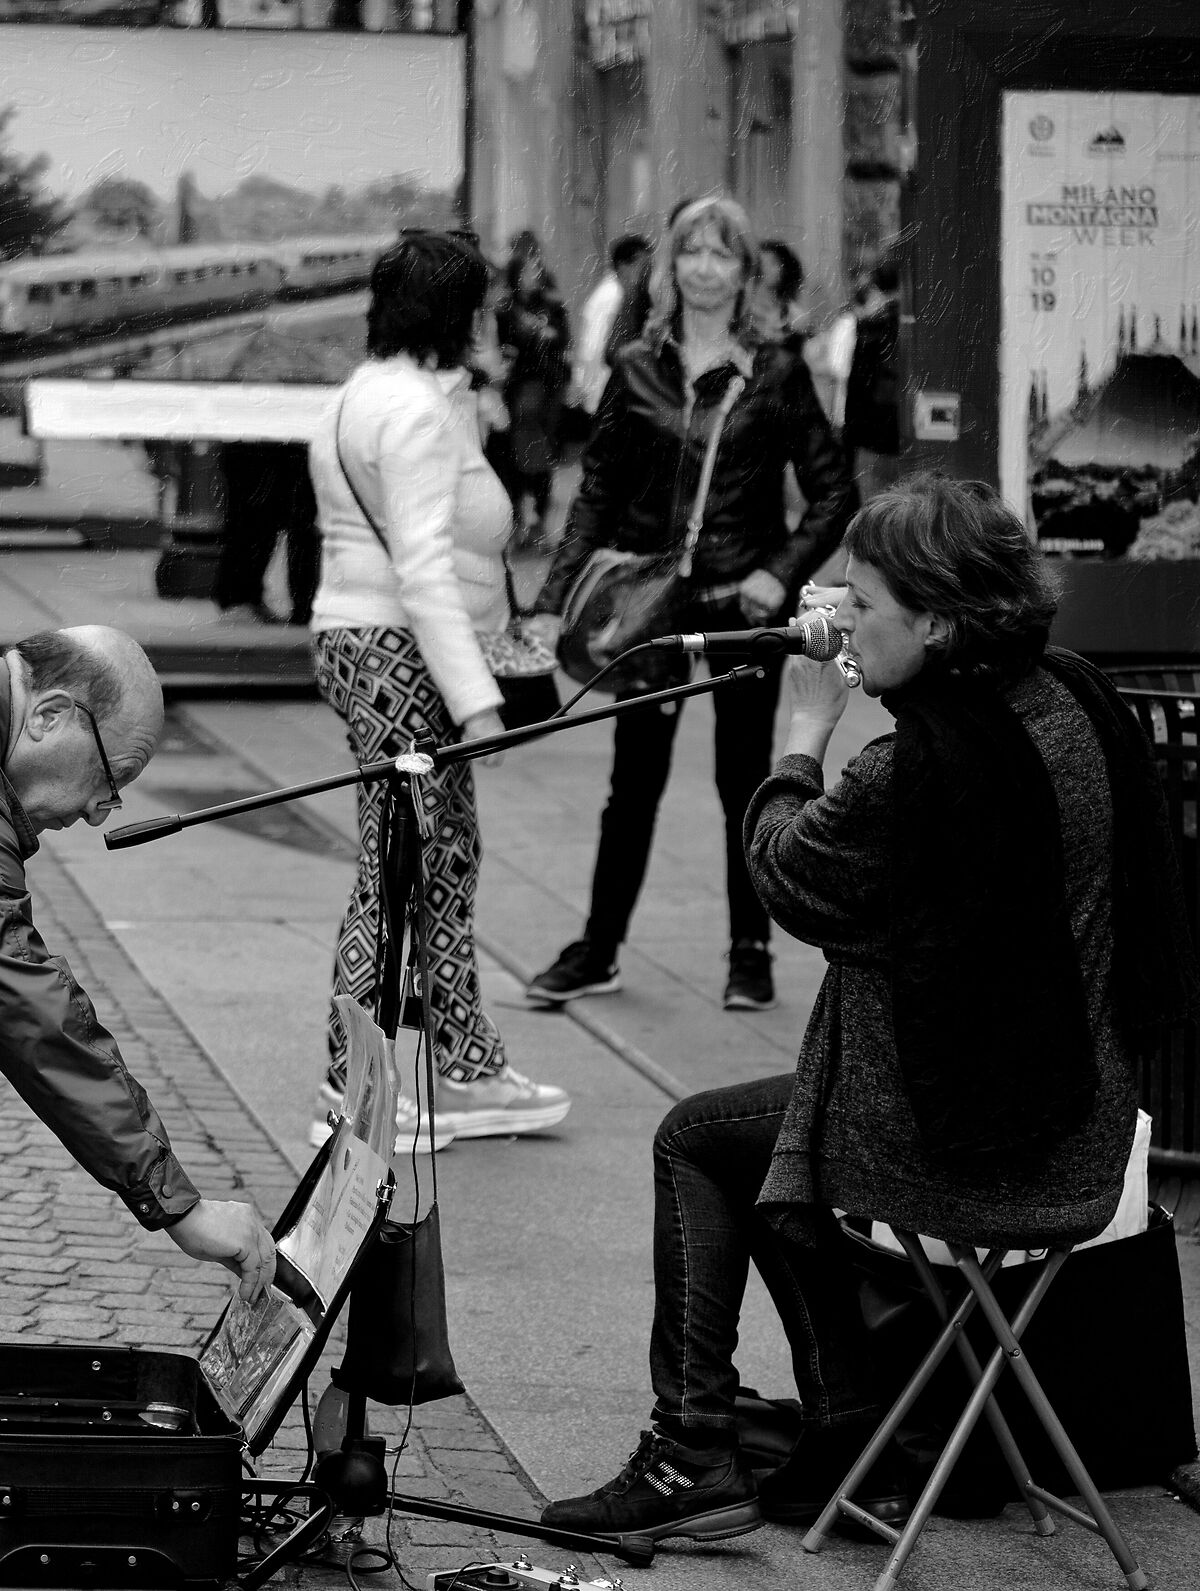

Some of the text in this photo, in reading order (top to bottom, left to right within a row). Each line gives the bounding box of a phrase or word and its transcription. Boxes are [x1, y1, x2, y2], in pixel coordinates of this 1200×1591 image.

[1062, 185, 1156, 205] MILANO
[1029, 205, 1157, 227] MONTAGNA
[1073, 227, 1155, 247] WEEK
[1031, 267, 1056, 287] 10
[1031, 291, 1056, 312] 19
